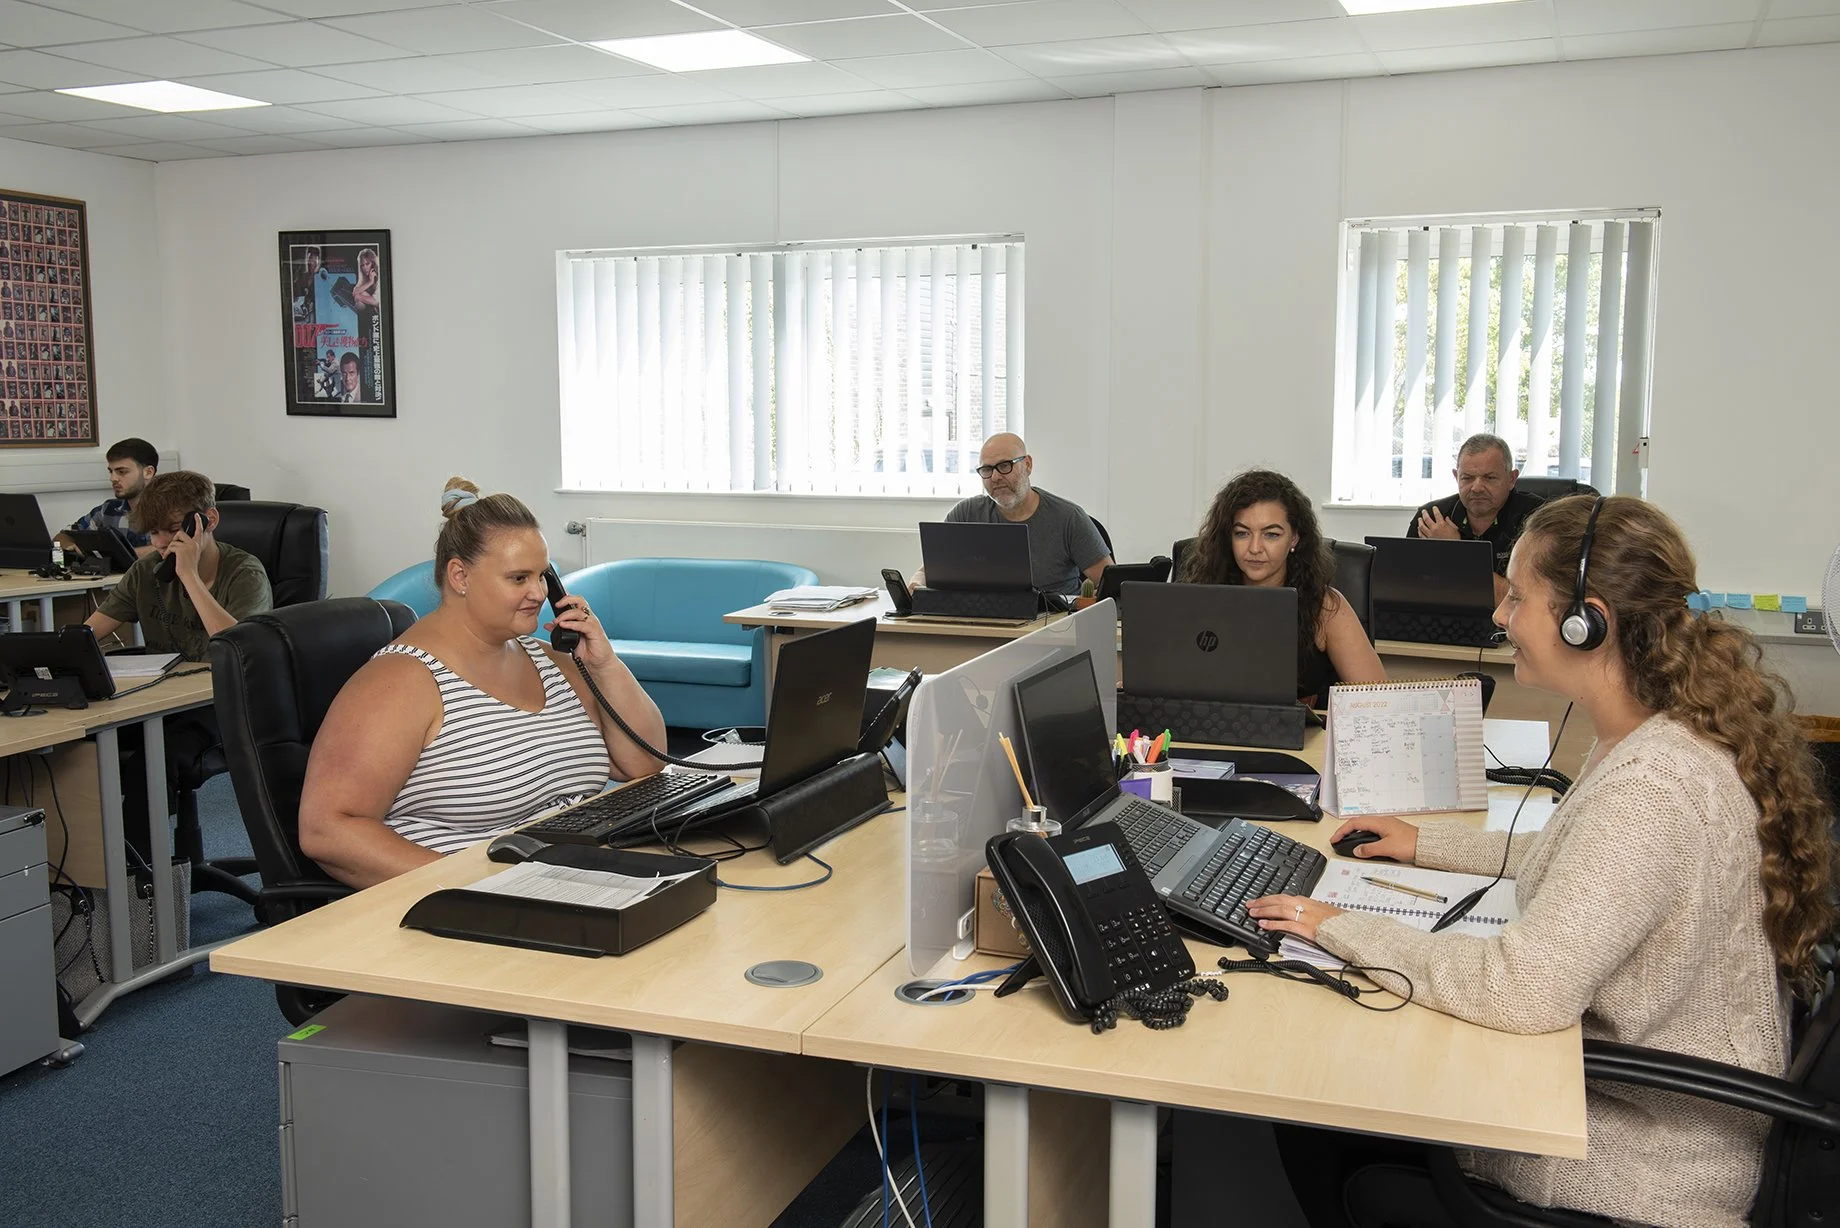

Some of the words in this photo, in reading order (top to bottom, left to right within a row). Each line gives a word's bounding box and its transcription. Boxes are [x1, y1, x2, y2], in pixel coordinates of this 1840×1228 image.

[1198, 631, 1217, 652] hp
[816, 692, 832, 706] acer
[1372, 701, 1388, 709] 2022
